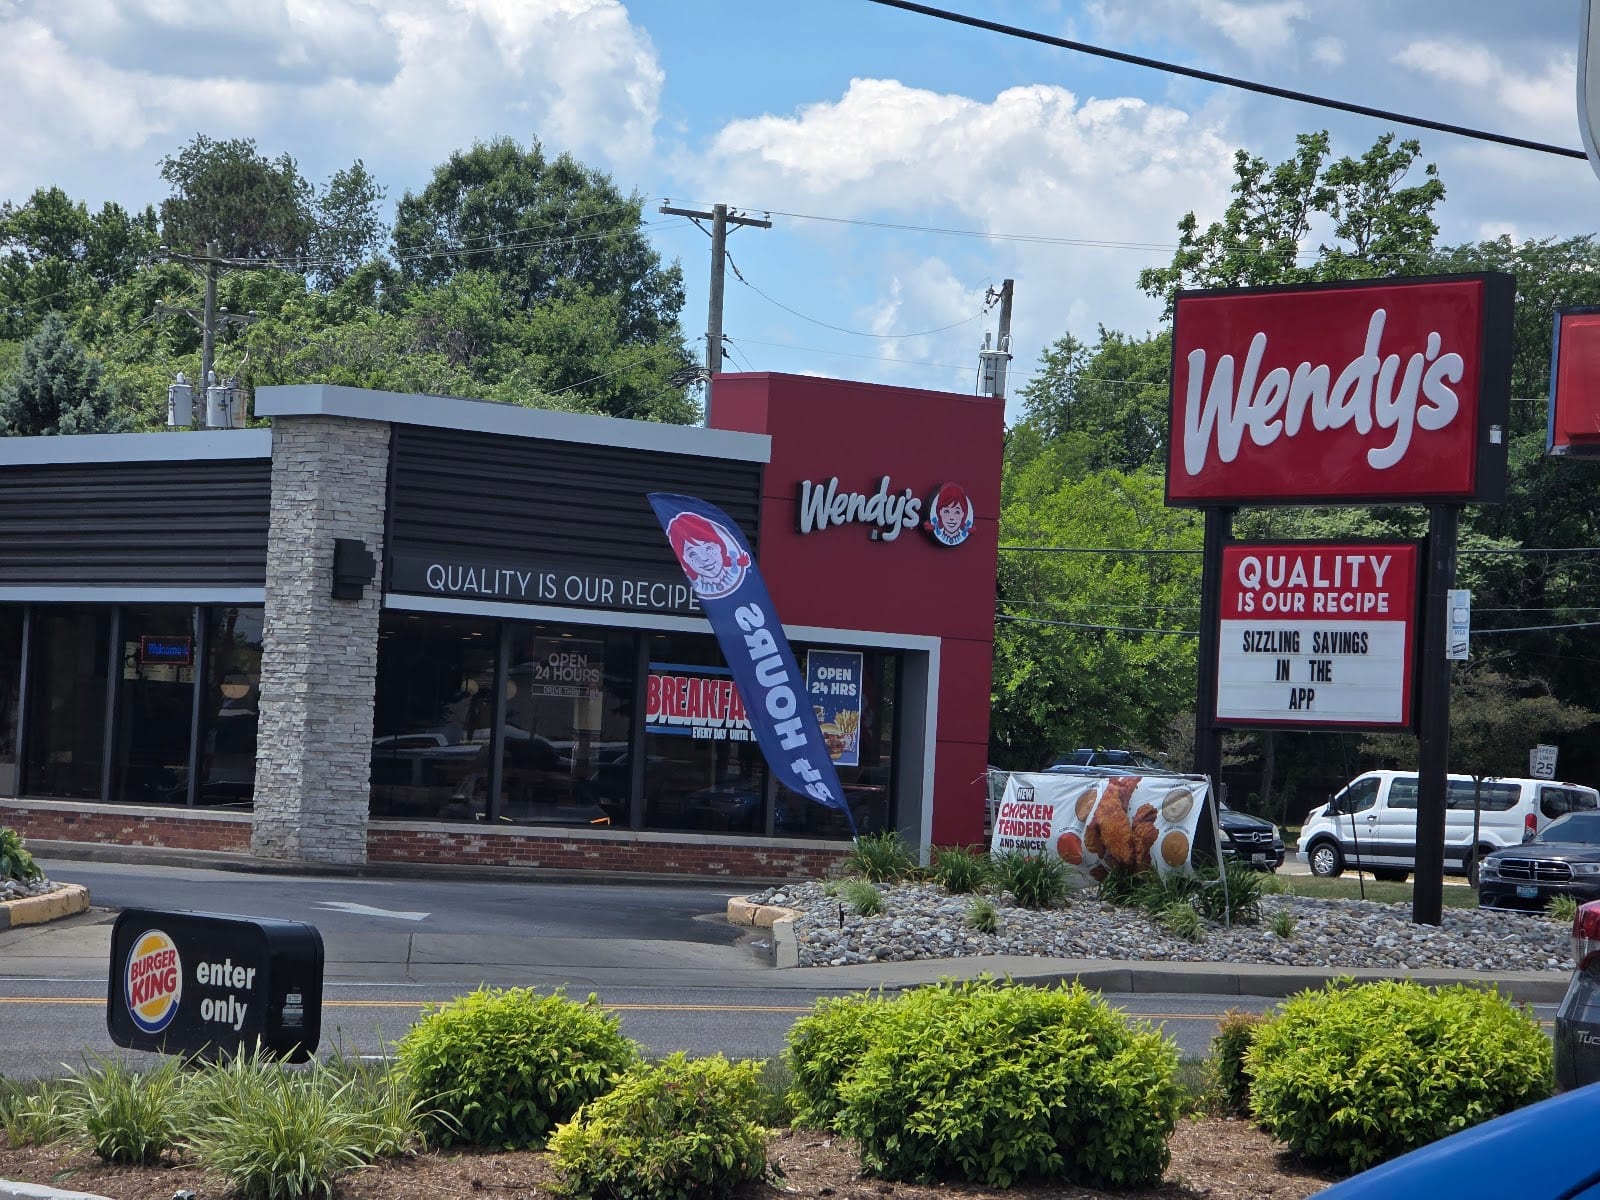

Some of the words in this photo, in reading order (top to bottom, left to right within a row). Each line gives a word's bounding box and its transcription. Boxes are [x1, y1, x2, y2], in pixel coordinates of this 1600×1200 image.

[1183, 308, 1465, 476] Wendy's
[800, 475, 922, 541] Wendy's
[1238, 555, 1393, 592] QUALITY
[426, 563, 532, 597] QUALITY
[538, 572, 557, 599] IS
[564, 575, 614, 604] OUR
[621, 580, 701, 611] RECIPE
[1237, 592, 1255, 613] IS
[1261, 592, 1306, 613] OUR
[1312, 592, 1390, 613] RECIPE
[1242, 630, 1301, 653] SIZZLING
[1312, 631, 1369, 654] SAVINGS
[548, 652, 588, 667] OPEN
[1275, 659, 1290, 681] IN
[1308, 659, 1332, 682] THE
[534, 665, 550, 680] 24
[553, 667, 600, 682] HOURS
[817, 666, 852, 681] OPEN
[811, 681, 829, 695] 24
[830, 682, 857, 697] HRS
[1288, 687, 1316, 710] APP
[646, 674, 752, 729] BREAKFA
[692, 727, 713, 740] EVERY
[1535, 761, 1554, 776] 25
[1017, 787, 1034, 801] NEW
[1001, 802, 1055, 821] CHICKEN
[997, 818, 1052, 839] TENDERS
[1000, 838, 1014, 849] AND
[1015, 839, 1047, 851] SAUCES
[130, 949, 176, 984] BURGER
[196, 958, 256, 990] enter
[130, 966, 177, 1010] KING
[200, 994, 248, 1032] only
